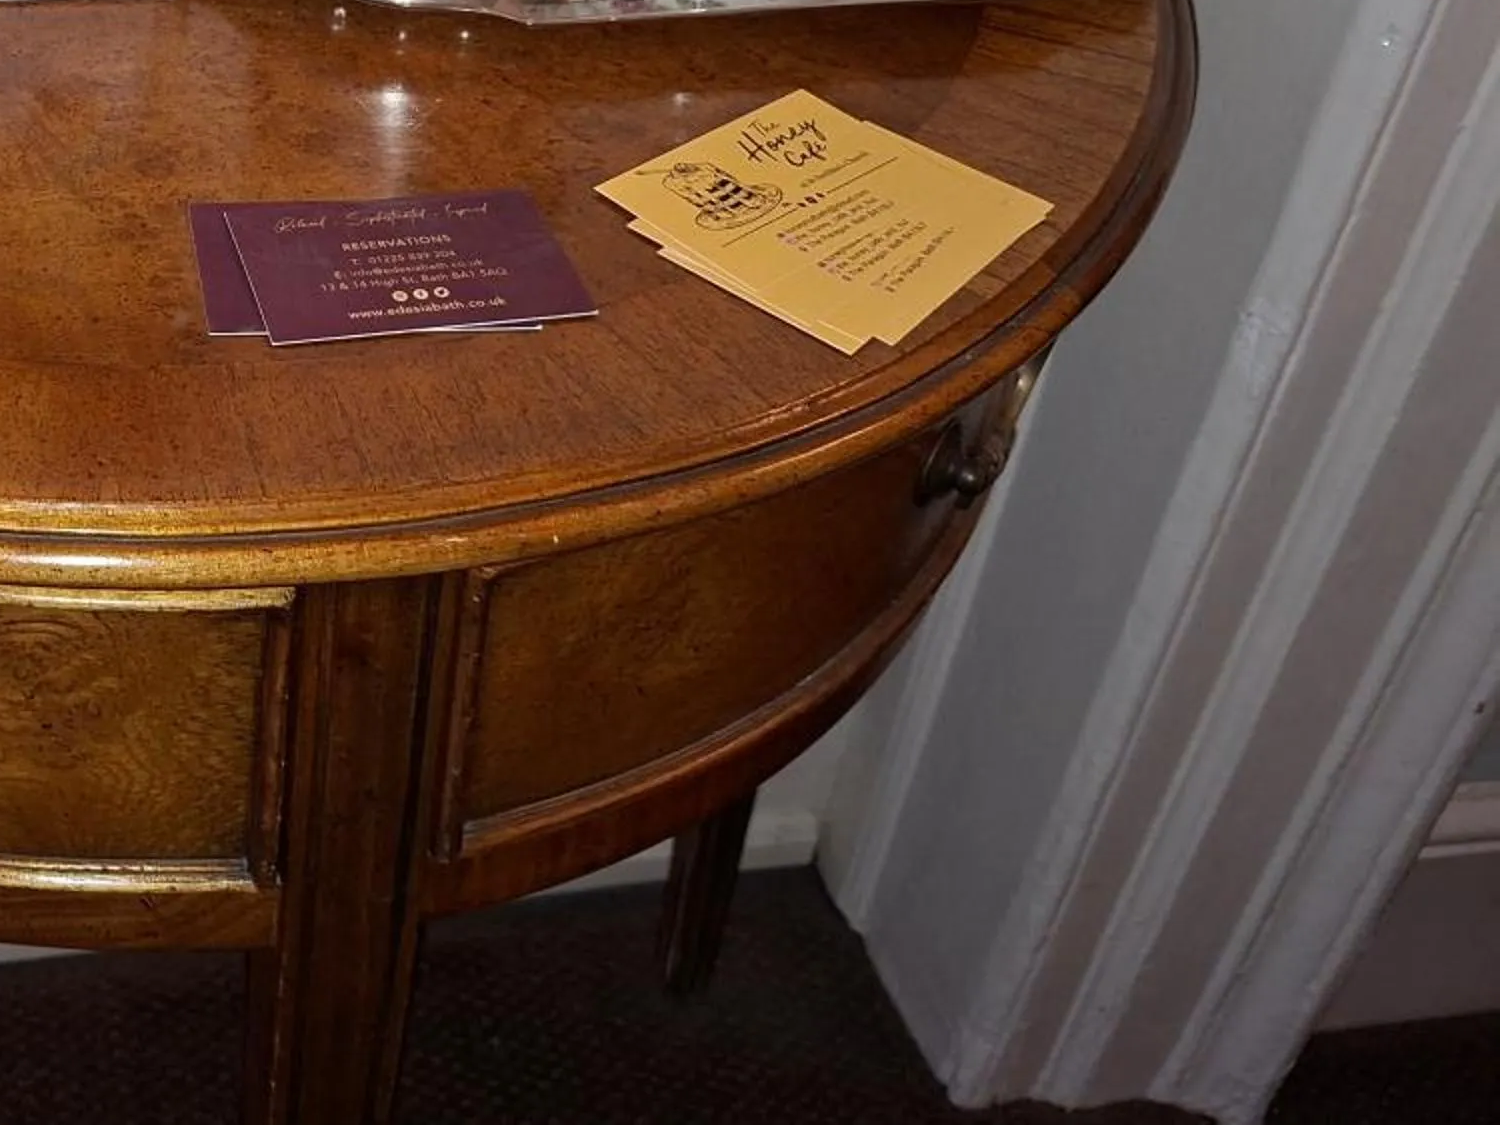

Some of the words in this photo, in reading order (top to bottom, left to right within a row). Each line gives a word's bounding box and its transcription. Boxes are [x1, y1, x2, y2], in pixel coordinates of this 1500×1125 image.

[746, 120, 781, 138] The
[737, 118, 827, 163] Honey
[341, 233, 453, 252] RESERVATIONS
[347, 296, 509, 320] www.edesiabath.co.uk
